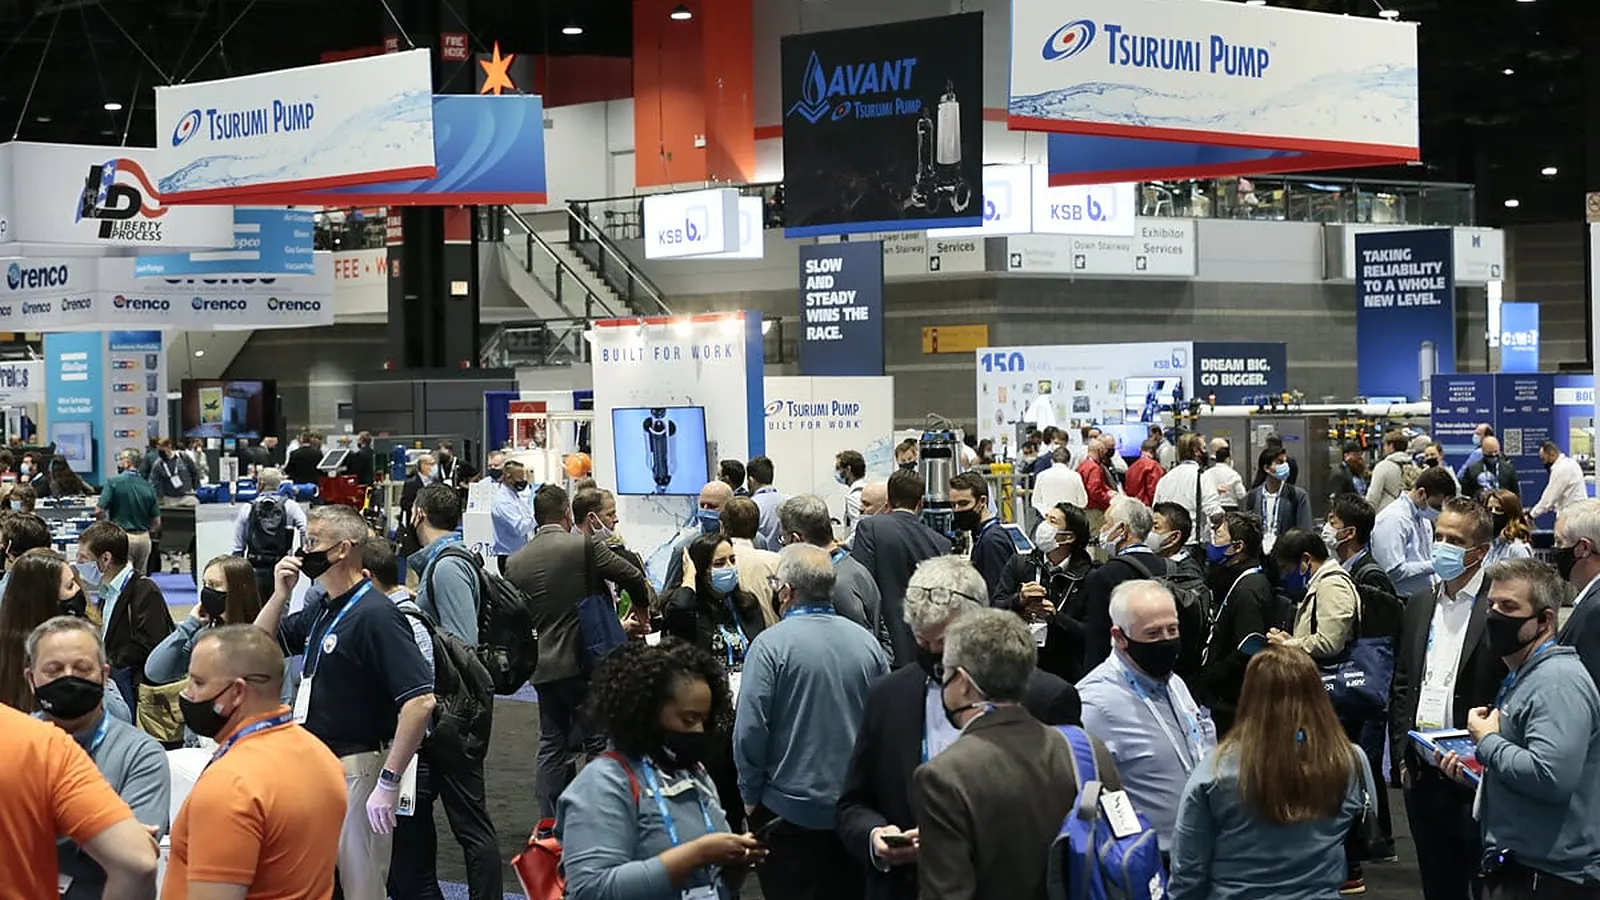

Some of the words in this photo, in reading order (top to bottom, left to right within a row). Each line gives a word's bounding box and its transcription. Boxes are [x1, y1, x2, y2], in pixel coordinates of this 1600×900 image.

[445, 36, 464, 46] FIRE
[1103, 23, 1201, 72] TSURUMI
[1209, 34, 1269, 78] PUMP
[826, 57, 917, 97] AVANT
[853, 101, 893, 119] TSURUMI
[895, 97, 922, 115] PUMP
[206, 107, 267, 141] TSURUMI
[273, 98, 314, 133] PUMP
[1050, 203, 1083, 221] KSB
[112, 220, 163, 231] LIBERTY
[1141, 226, 1184, 240] Exhibitor
[110, 230, 163, 241] PROCESS
[233, 237, 260, 249] opco
[658, 228, 683, 245] KSB
[895, 244, 925, 255] Stairway
[937, 241, 976, 254] Services
[1143, 242, 1184, 255] Services
[1362, 248, 1412, 262] TAKING
[333, 258, 359, 279] FEE
[805, 258, 843, 274] SLOW
[1363, 262, 1443, 277] RELIABILITY
[7, 262, 69, 290] Orenco
[806, 275, 834, 290] AND
[1363, 280, 1382, 293] TO
[1385, 279, 1396, 292] A
[1398, 277, 1445, 291] WHOLE
[22, 301, 52, 315] Orenco
[61, 297, 92, 312] Orenco
[113, 295, 171, 310] Orenco
[191, 296, 247, 310] Orenco
[267, 296, 322, 311] Orenco
[805, 290, 857, 306] STEADY
[1364, 294, 1394, 308] NEW
[1397, 292, 1442, 306] LEVEL.
[806, 307, 841, 323] WINS
[842, 306, 869, 321] THE
[806, 325, 844, 340] RACE.
[602, 348, 644, 362] BUILT
[653, 347, 681, 361] FOR
[691, 344, 733, 359] WORK
[981, 352, 1025, 373] 150
[1153, 359, 1171, 369] KSB
[1201, 358, 1245, 371] DREAM
[1246, 358, 1271, 371] BIG.
[1201, 373, 1219, 386] GO
[1221, 372, 1268, 386] BIGGER.
[786, 400, 829, 417] TSURUMI
[832, 400, 860, 416] PUMP
[768, 420, 794, 430] UILT
[800, 420, 821, 430] FOR
[829, 419, 860, 429] WORK
